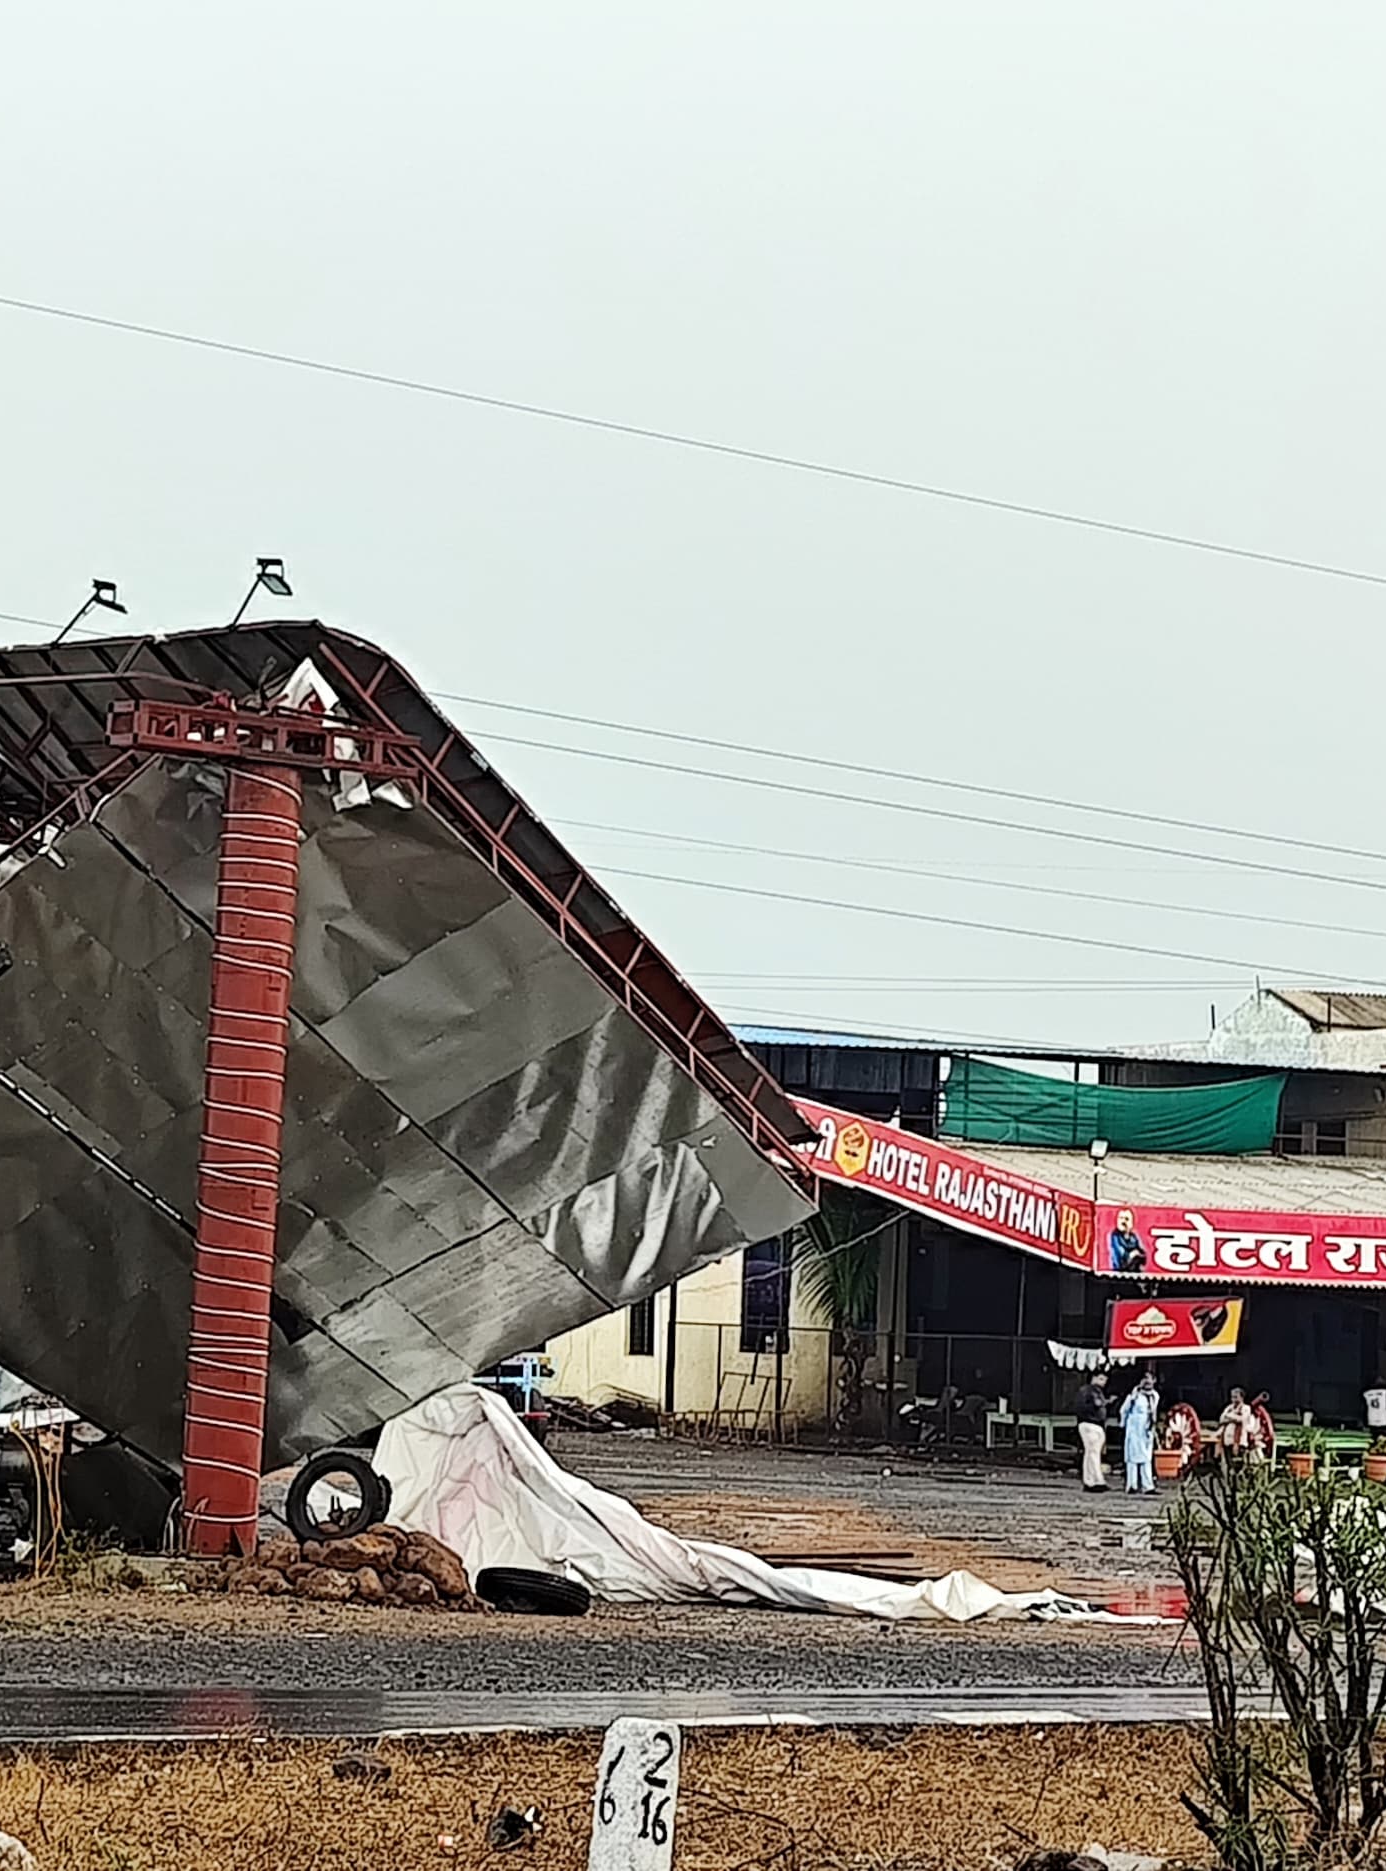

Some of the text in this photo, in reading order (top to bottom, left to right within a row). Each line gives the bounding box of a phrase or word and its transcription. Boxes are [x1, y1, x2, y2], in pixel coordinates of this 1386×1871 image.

[867, 1139, 931, 1196] HOTEL
[934, 1162, 1056, 1244] RAJASTHANI
[1150, 1212, 1314, 1272] होटल
[643, 1731, 674, 1789] 2
[638, 1790, 671, 1846] 16
